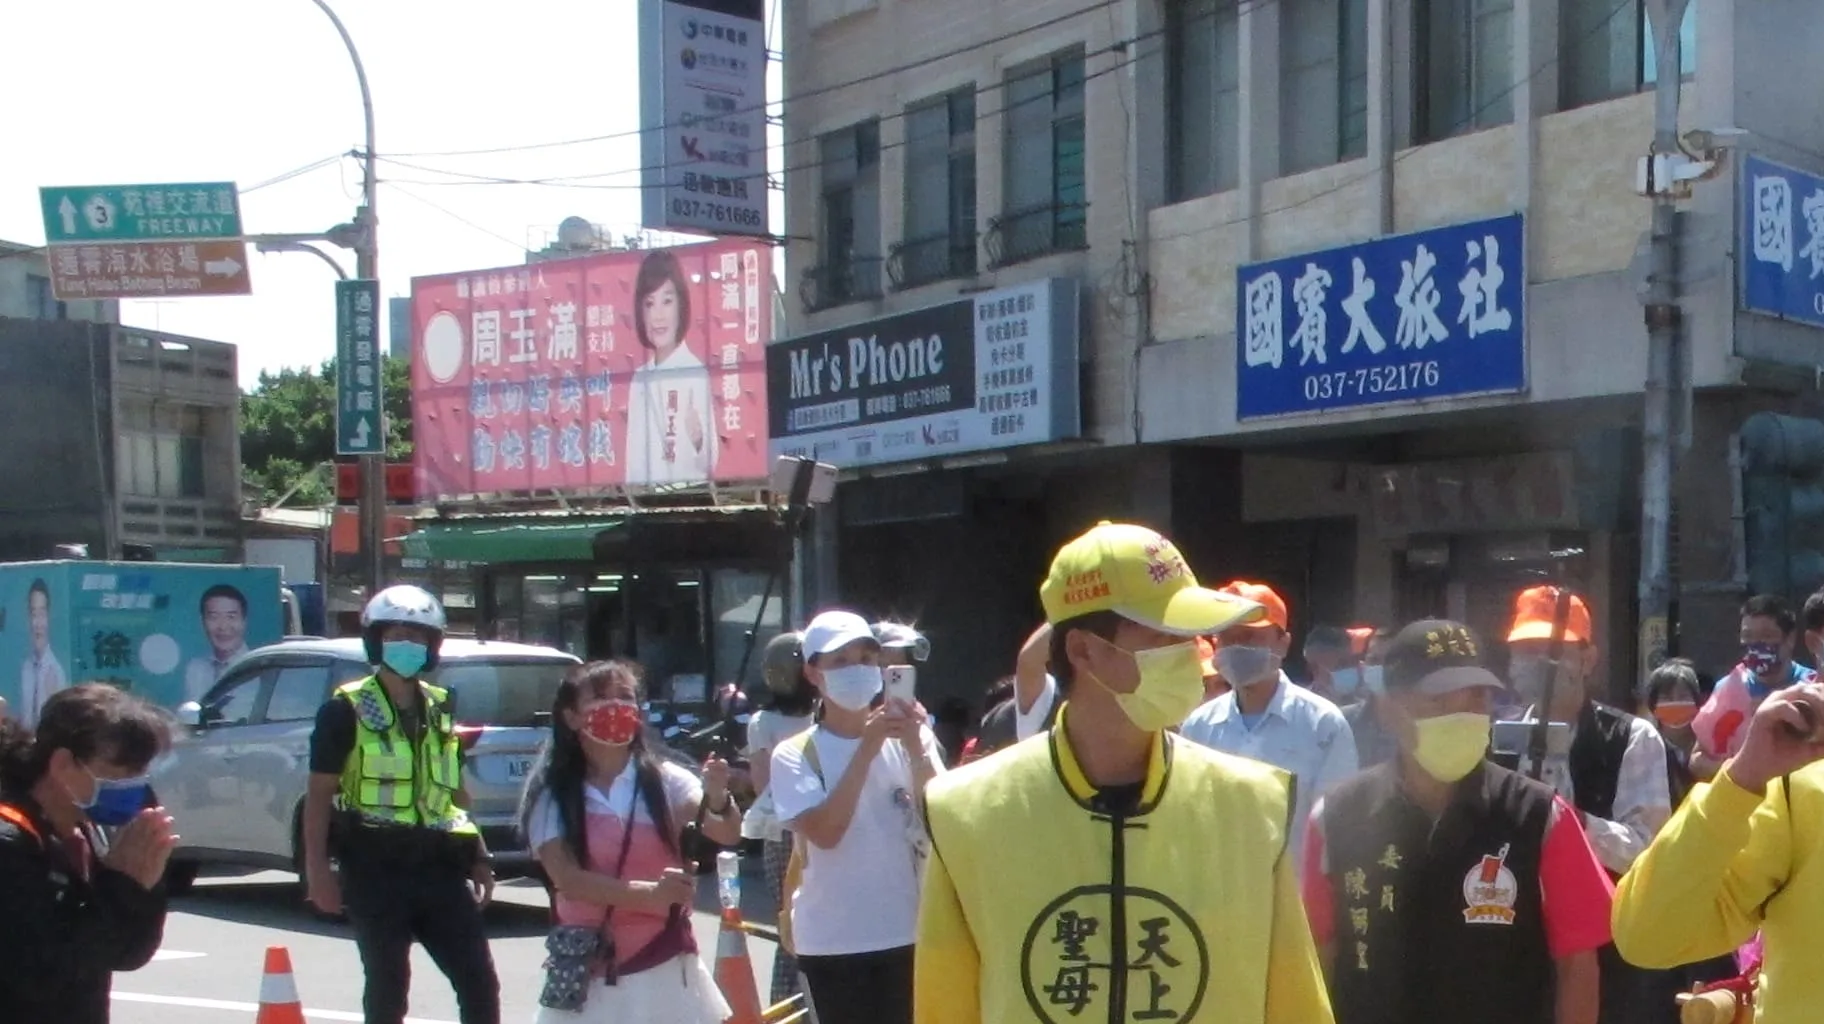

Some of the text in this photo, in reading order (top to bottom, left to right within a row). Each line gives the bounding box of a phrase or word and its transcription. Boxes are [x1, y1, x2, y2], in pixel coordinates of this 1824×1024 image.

[94, 204, 109, 224] 3
[136, 217, 226, 235] FREEWAY
[56, 244, 200, 277] 通霄海水浴場
[472, 302, 578, 367] 周玉滿
[1245, 234, 1512, 370] 國賓大旅社
[720, 252, 741, 432] 阿滿一直都在
[789, 334, 944, 399] Mr's Phone
[1304, 360, 1440, 401] 037-752176
[1043, 910, 1099, 1017] 聖母
[1132, 916, 1181, 1021] 天上
